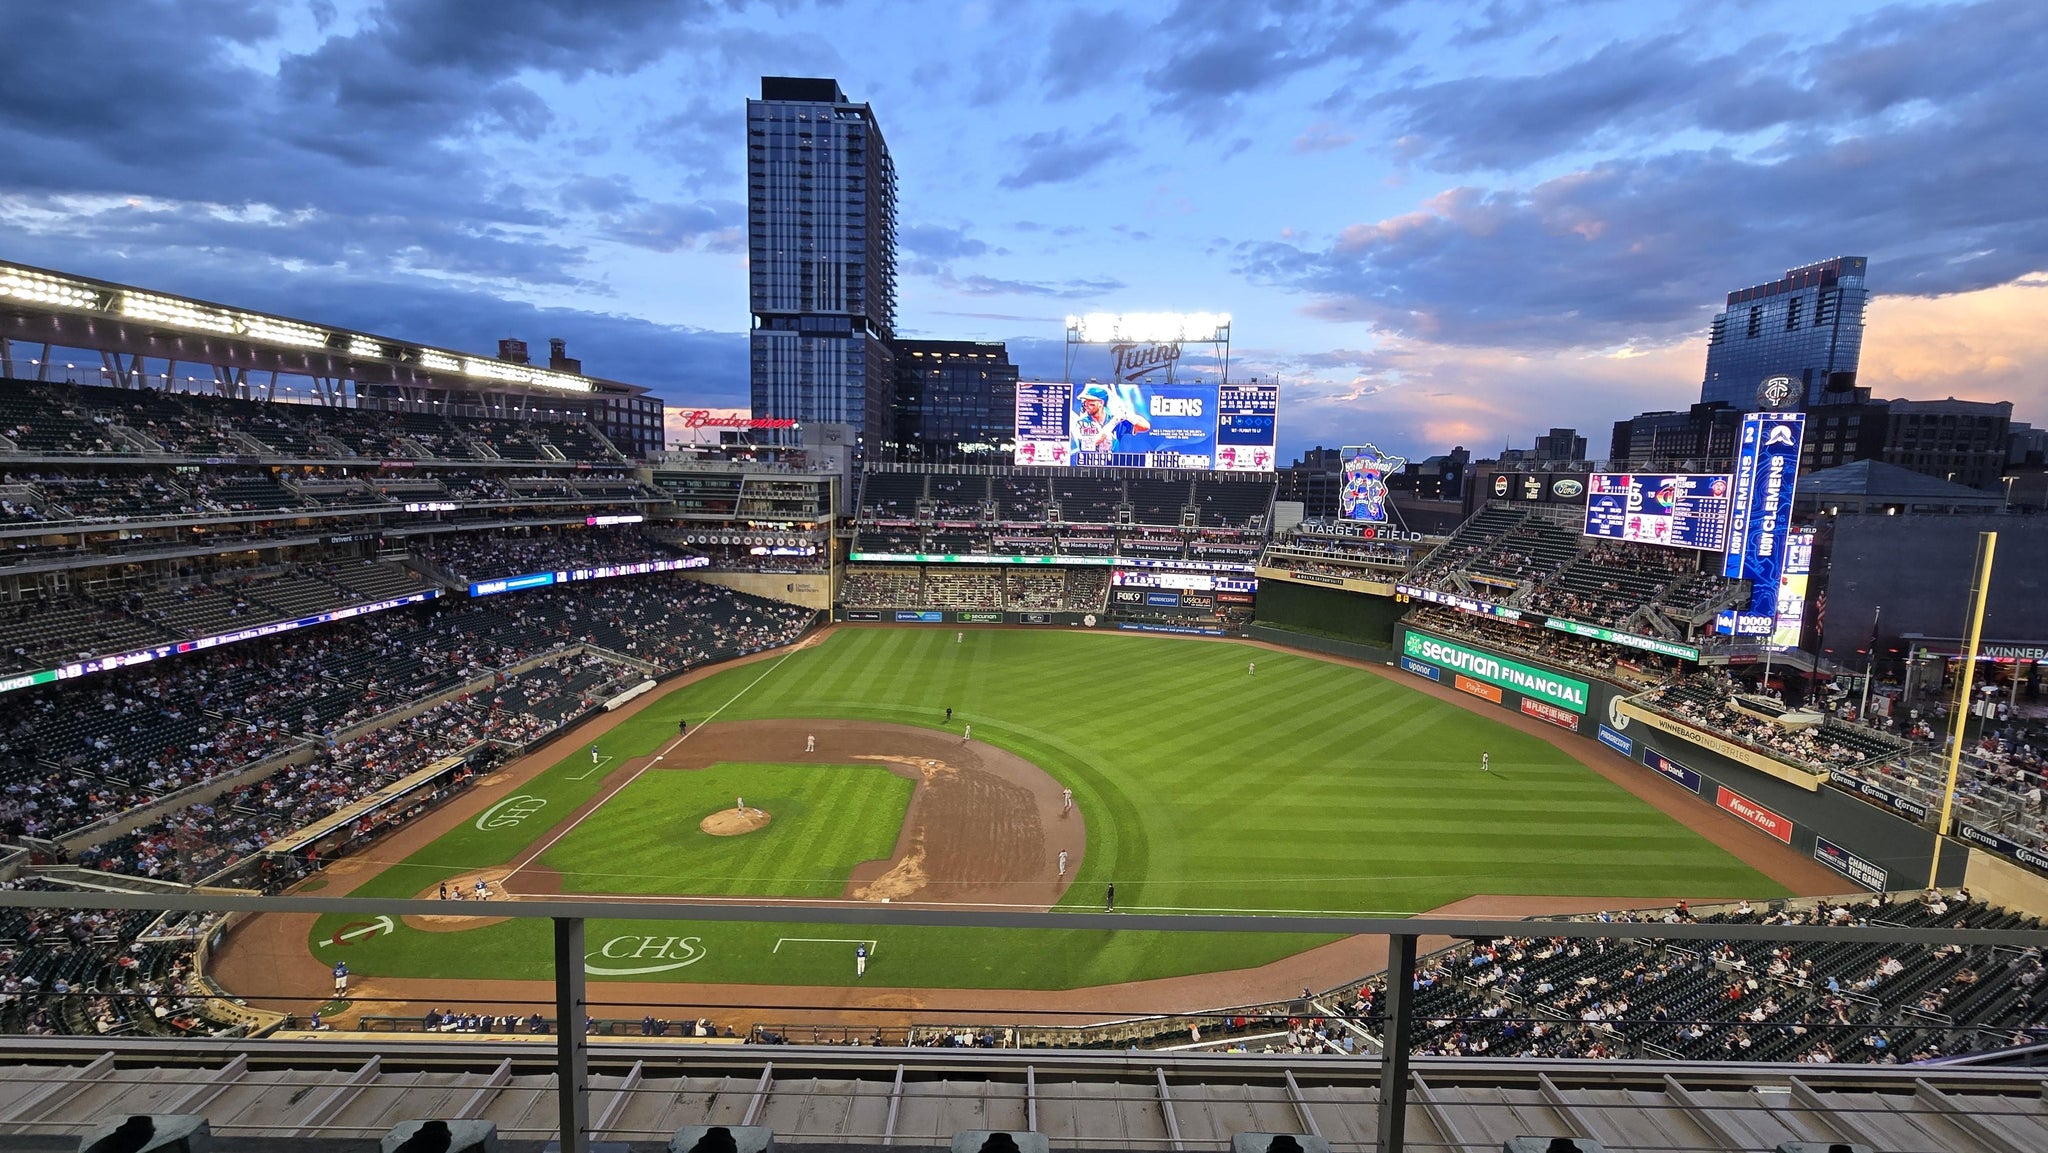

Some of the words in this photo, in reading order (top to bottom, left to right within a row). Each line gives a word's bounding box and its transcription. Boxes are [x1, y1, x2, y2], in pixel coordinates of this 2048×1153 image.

[1110, 342, 1181, 376] Twins
[680, 410, 797, 428] Budweiser
[1745, 427, 1754, 443] 2
[1558, 483, 1576, 494] Ford
[1734, 455, 1752, 530] CLEMENS
[1763, 455, 1784, 532] CLEMENS
[1309, 525, 1362, 537] TARGET
[1377, 530, 1422, 542] FIELD
[1730, 530, 1743, 554] KODY
[1759, 533, 1774, 556] KODY
[1117, 592, 1133, 600] FOX
[1134, 593, 1140, 601] 9
[1576, 624, 1599, 635] securian
[1738, 626, 1771, 634] LAKES
[1739, 615, 1772, 626] 10000
[1612, 632, 1655, 650] securian
[1655, 643, 1696, 658] FINANCIAL
[1408, 661, 1431, 675] uponor
[1422, 640, 1499, 679] securian
[1501, 666, 1584, 705] FINANCIAL
[1466, 681, 1489, 696] Paycor
[1532, 702, 1549, 715] PLACE
[1558, 711, 1572, 723] HERE
[1599, 728, 1631, 753] PROGRESSIVE
[1658, 719, 1701, 742] WINNEBAGO
[1701, 734, 1751, 762] INDUSTRIES
[1668, 763, 1685, 779] bank
[1831, 771, 1856, 788] Corona
[1861, 784, 1889, 802] Corona
[488, 798, 548, 828] CHS
[1894, 792, 1924, 816] Corona
[1962, 826, 1998, 847] Corona
[1848, 856, 1885, 882] CHANGING
[1848, 865, 1861, 879] THE
[1861, 873, 1883, 890] GAME
[601, 935, 702, 960] CHS
